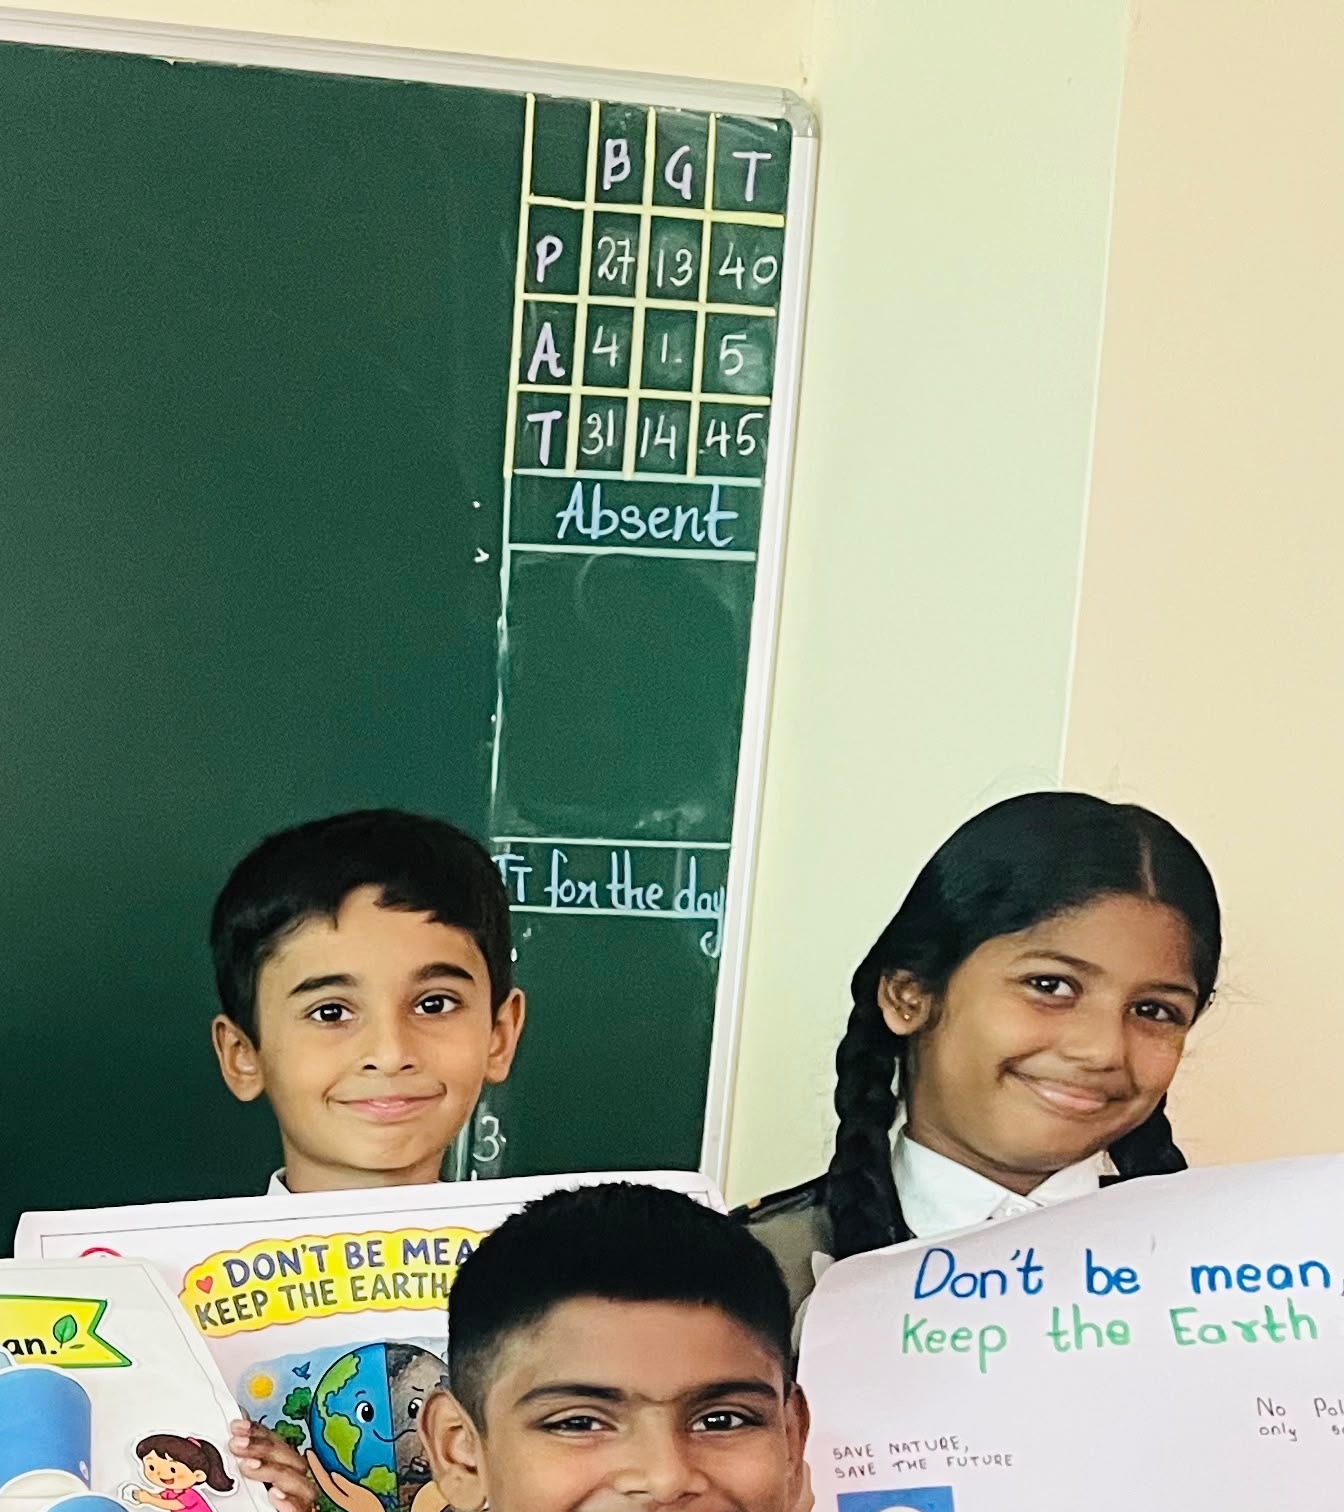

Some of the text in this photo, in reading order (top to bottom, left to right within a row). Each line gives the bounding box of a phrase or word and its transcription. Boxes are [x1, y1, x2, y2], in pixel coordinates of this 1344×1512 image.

[603, 138, 772, 201] B G T
[536, 235, 777, 290] P 27 13 40
[527, 322, 748, 382] A 4 5
[526, 409, 763, 466] T 31 14 45
[556, 481, 738, 546] Absent
[544, 848, 726, 957] for the day
[223, 1238, 386, 1289] DON'T BE
[914, 1247, 1044, 1300] Don't
[1086, 1248, 1140, 1295] be
[195, 1270, 450, 1331] KEEP THE EARTH
[901, 1298, 1319, 1373] Keep the Earth
[832, 1436, 970, 1461] SAVE NATURE,
[834, 1453, 1014, 1479] SAVE THE FUTURE
